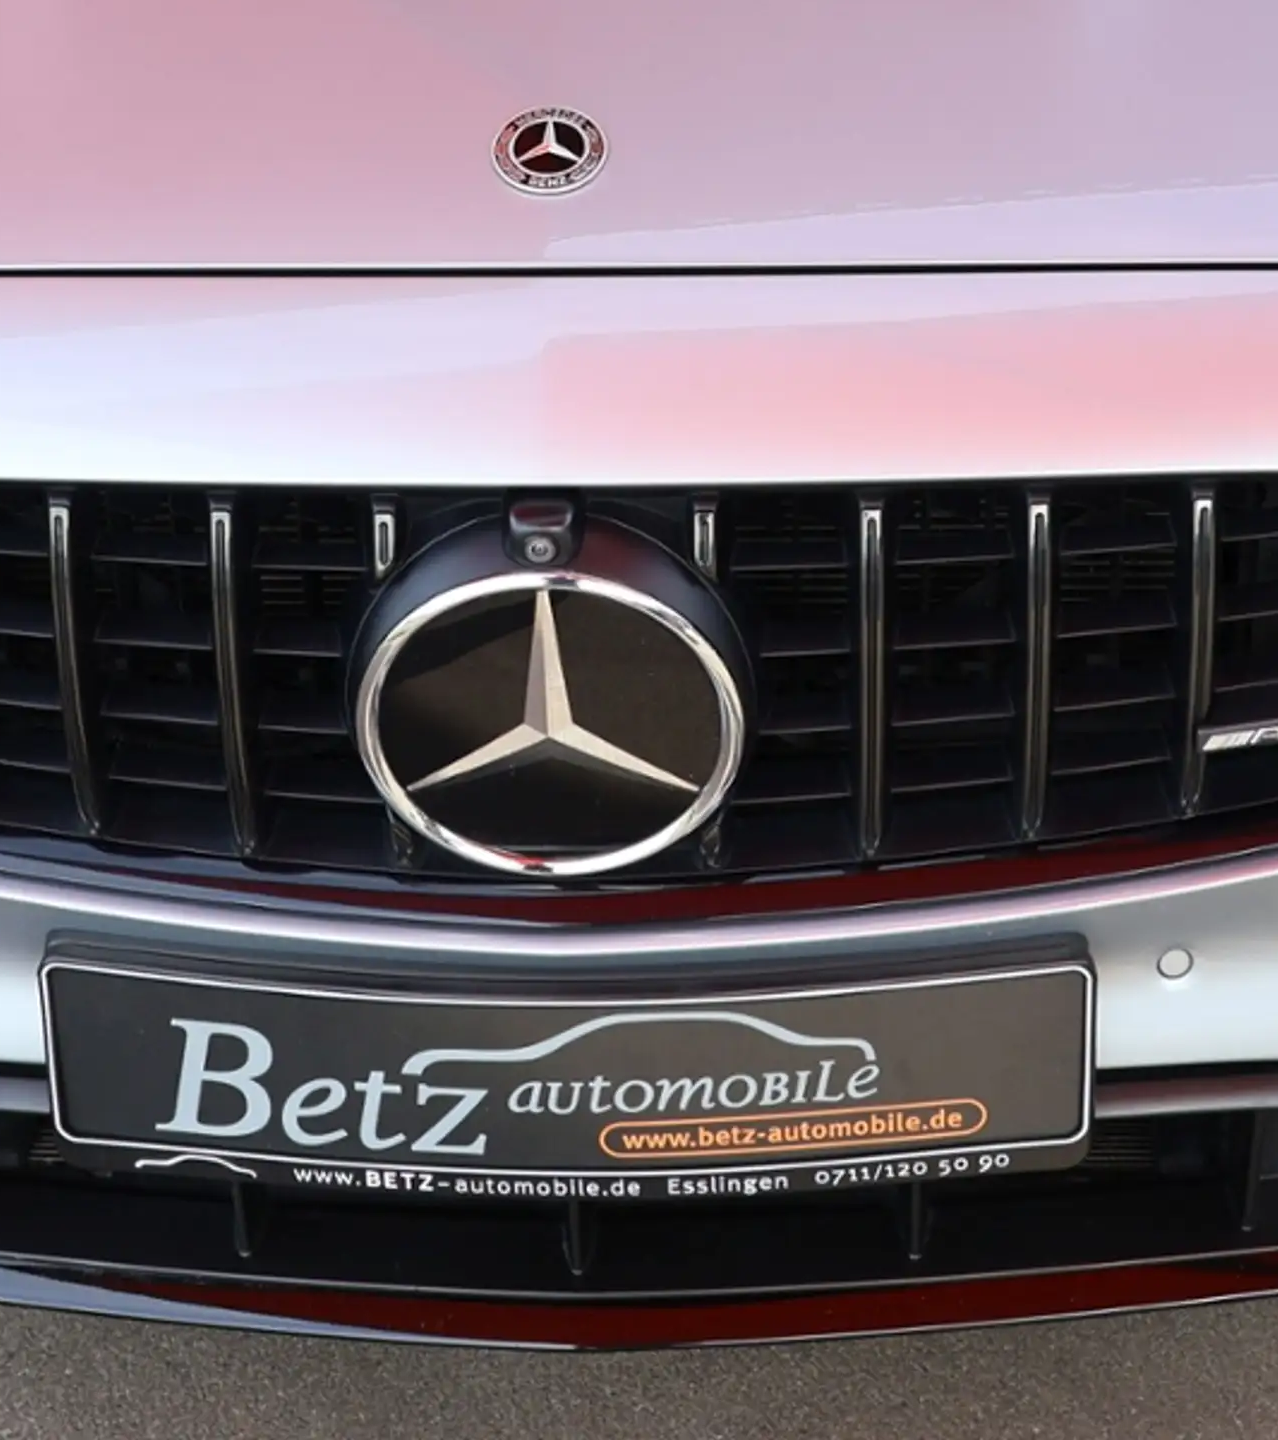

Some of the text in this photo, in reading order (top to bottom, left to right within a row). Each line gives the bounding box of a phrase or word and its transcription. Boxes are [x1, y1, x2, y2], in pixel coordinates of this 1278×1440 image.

[155, 1017, 488, 1156] Betz
[621, 1108, 964, 1151] www.betz-automobile.de
[293, 1153, 1010, 1198] www.BETZ-automobile.de Esslingen 0711/120 50 90
